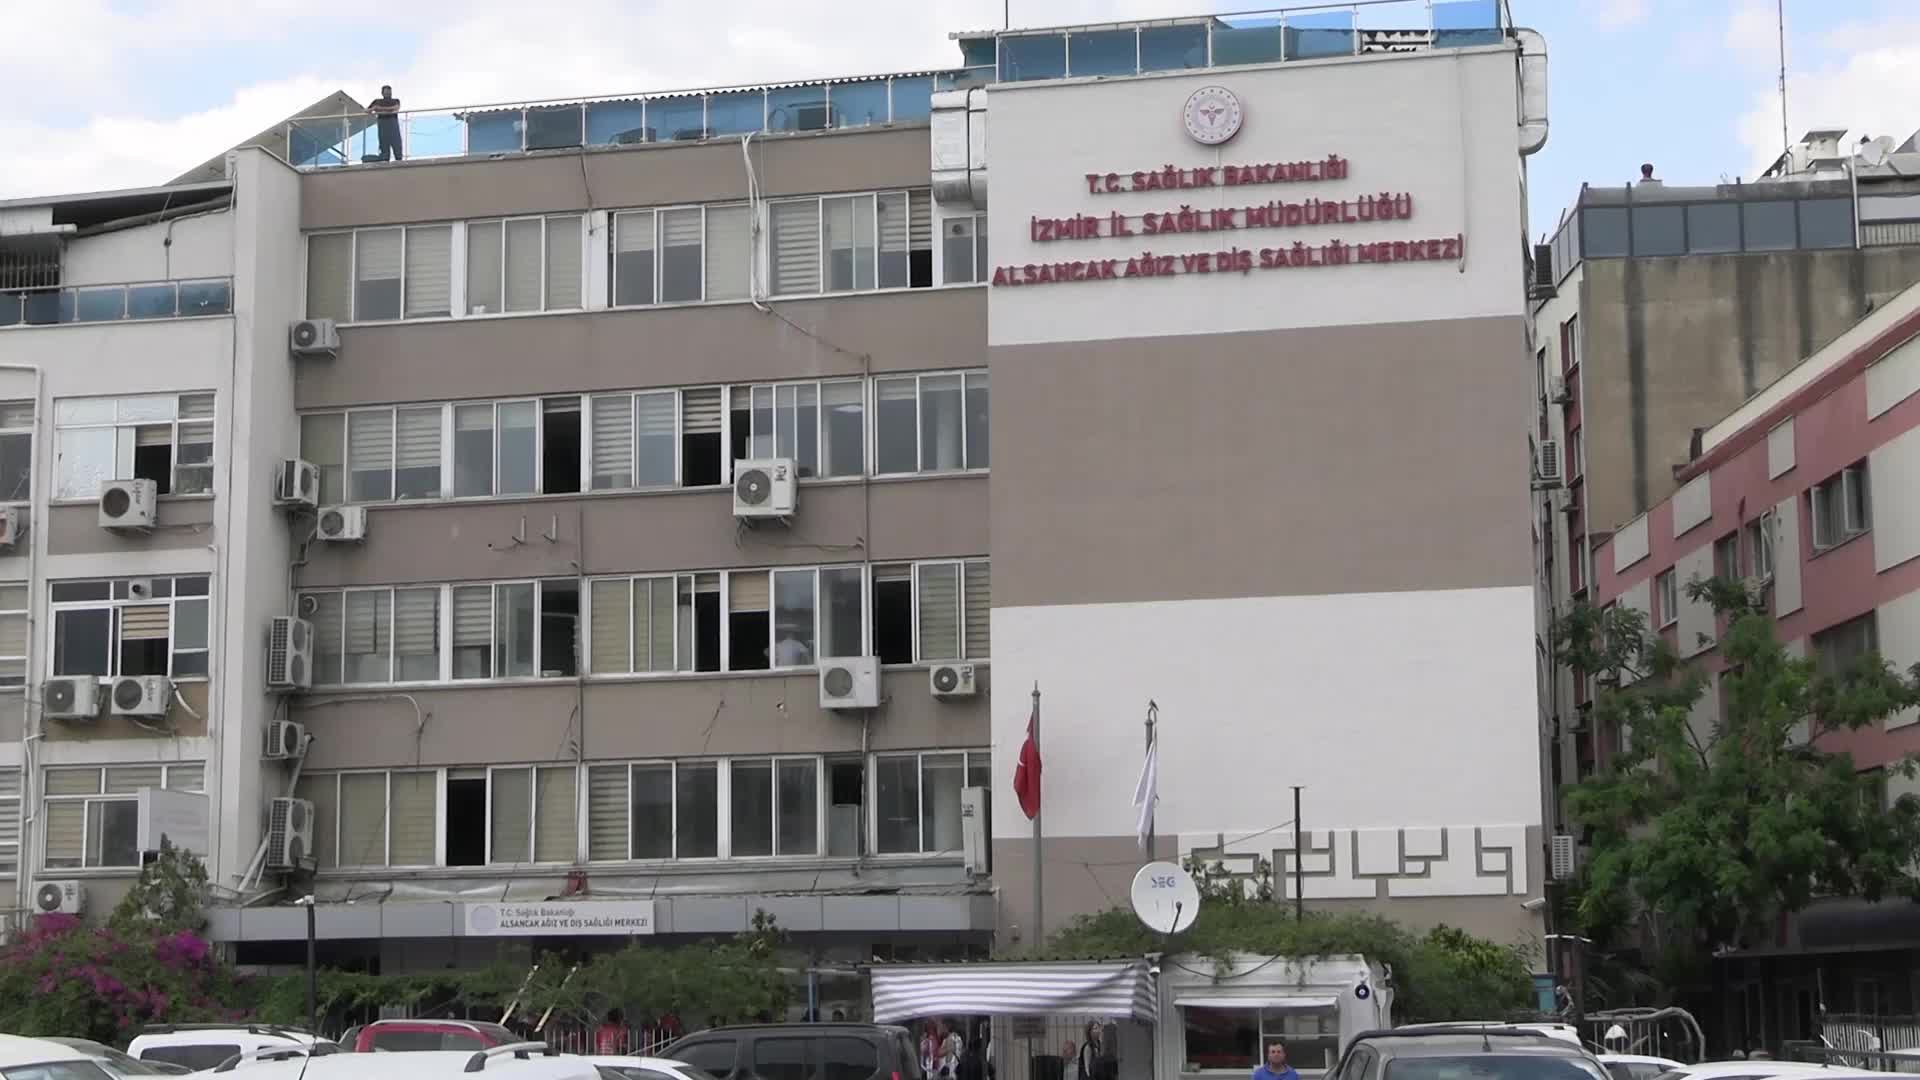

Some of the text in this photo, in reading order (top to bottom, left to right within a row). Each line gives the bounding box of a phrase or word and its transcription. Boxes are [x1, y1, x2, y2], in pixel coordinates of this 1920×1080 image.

[1086, 154, 1348, 193] T.C. SAĞLIK BAKANLIĞI
[1031, 192, 1412, 242] İZMİR İL SAĞLIK MÜDÜRLÜĞÜ
[992, 233, 1464, 286] ALSANCAK AĞIZ VE DİŞ SAĞLIĞI MERKEZİ
[500, 919, 540, 928] ALSANCAK
[560, 919, 569, 928] VE
